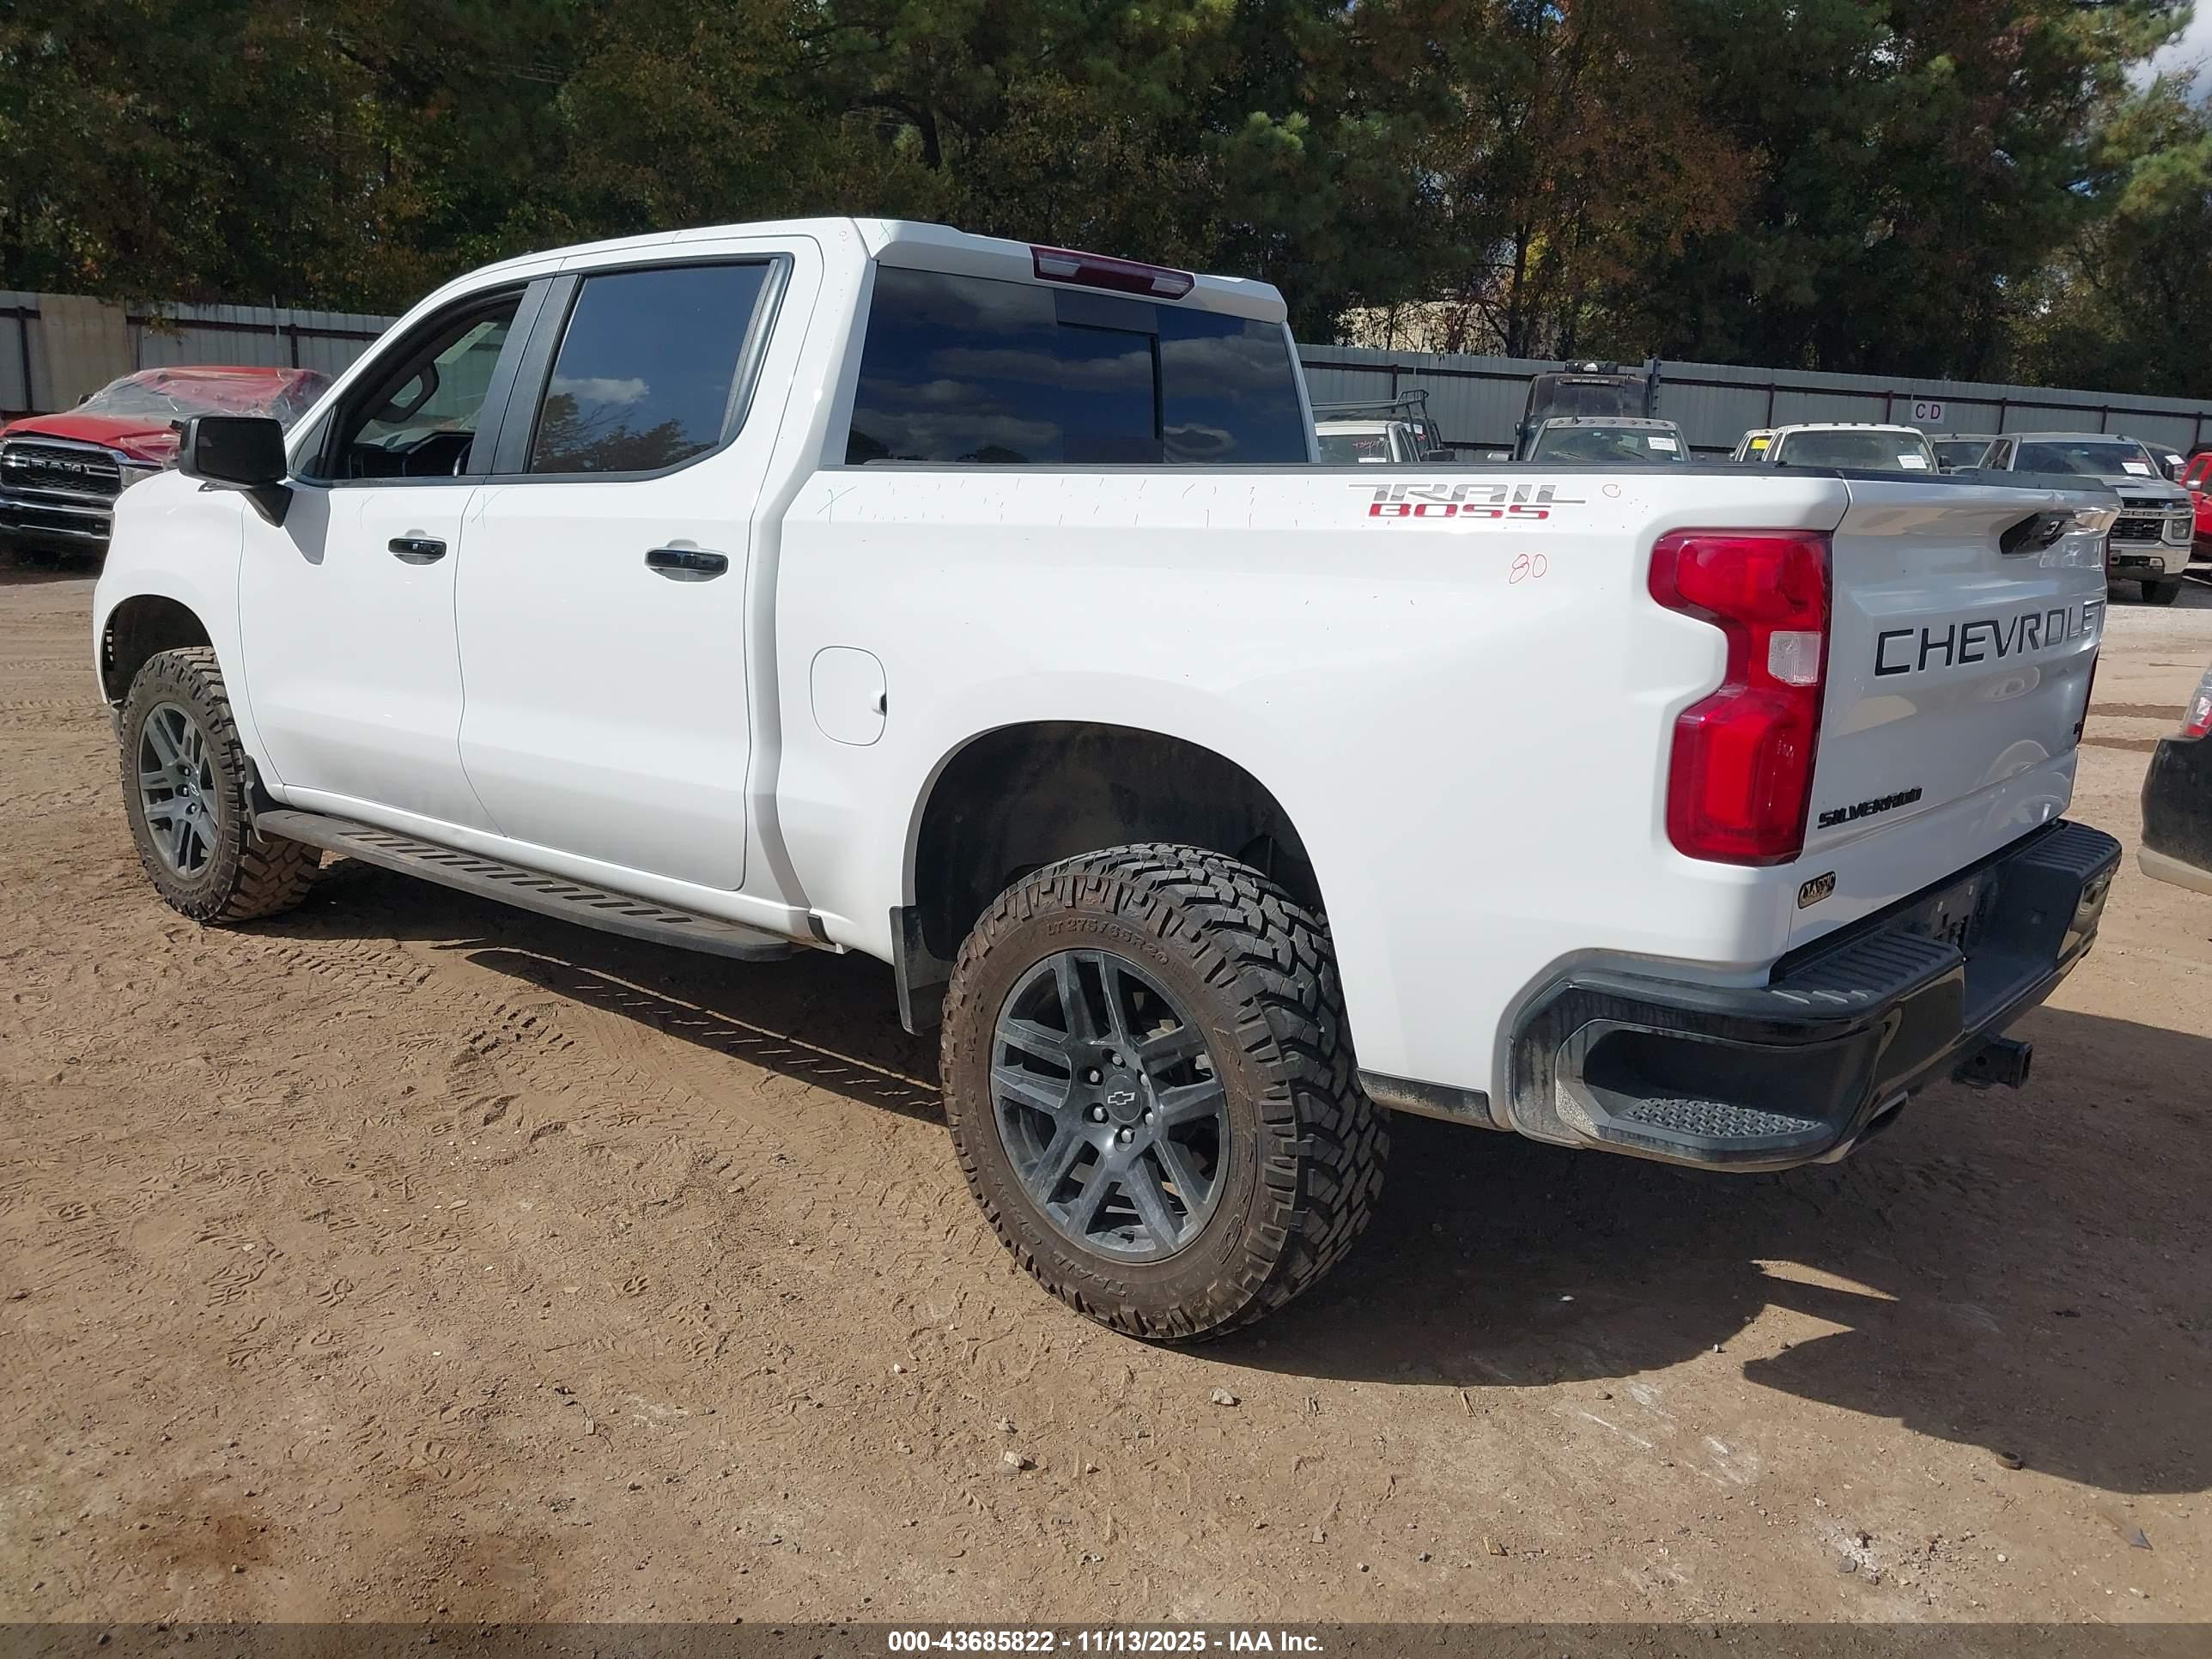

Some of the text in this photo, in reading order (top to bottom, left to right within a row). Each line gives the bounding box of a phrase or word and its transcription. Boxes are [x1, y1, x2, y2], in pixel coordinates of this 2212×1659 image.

[1916, 404, 1941, 419] C D
[1347, 483, 1587, 505] TRAIL
[1368, 502, 1552, 520] BOSS
[1509, 553, 1547, 585] 80
[1875, 599, 2106, 676] CHEVROLET
[1817, 787, 1923, 830] SILVERADO
